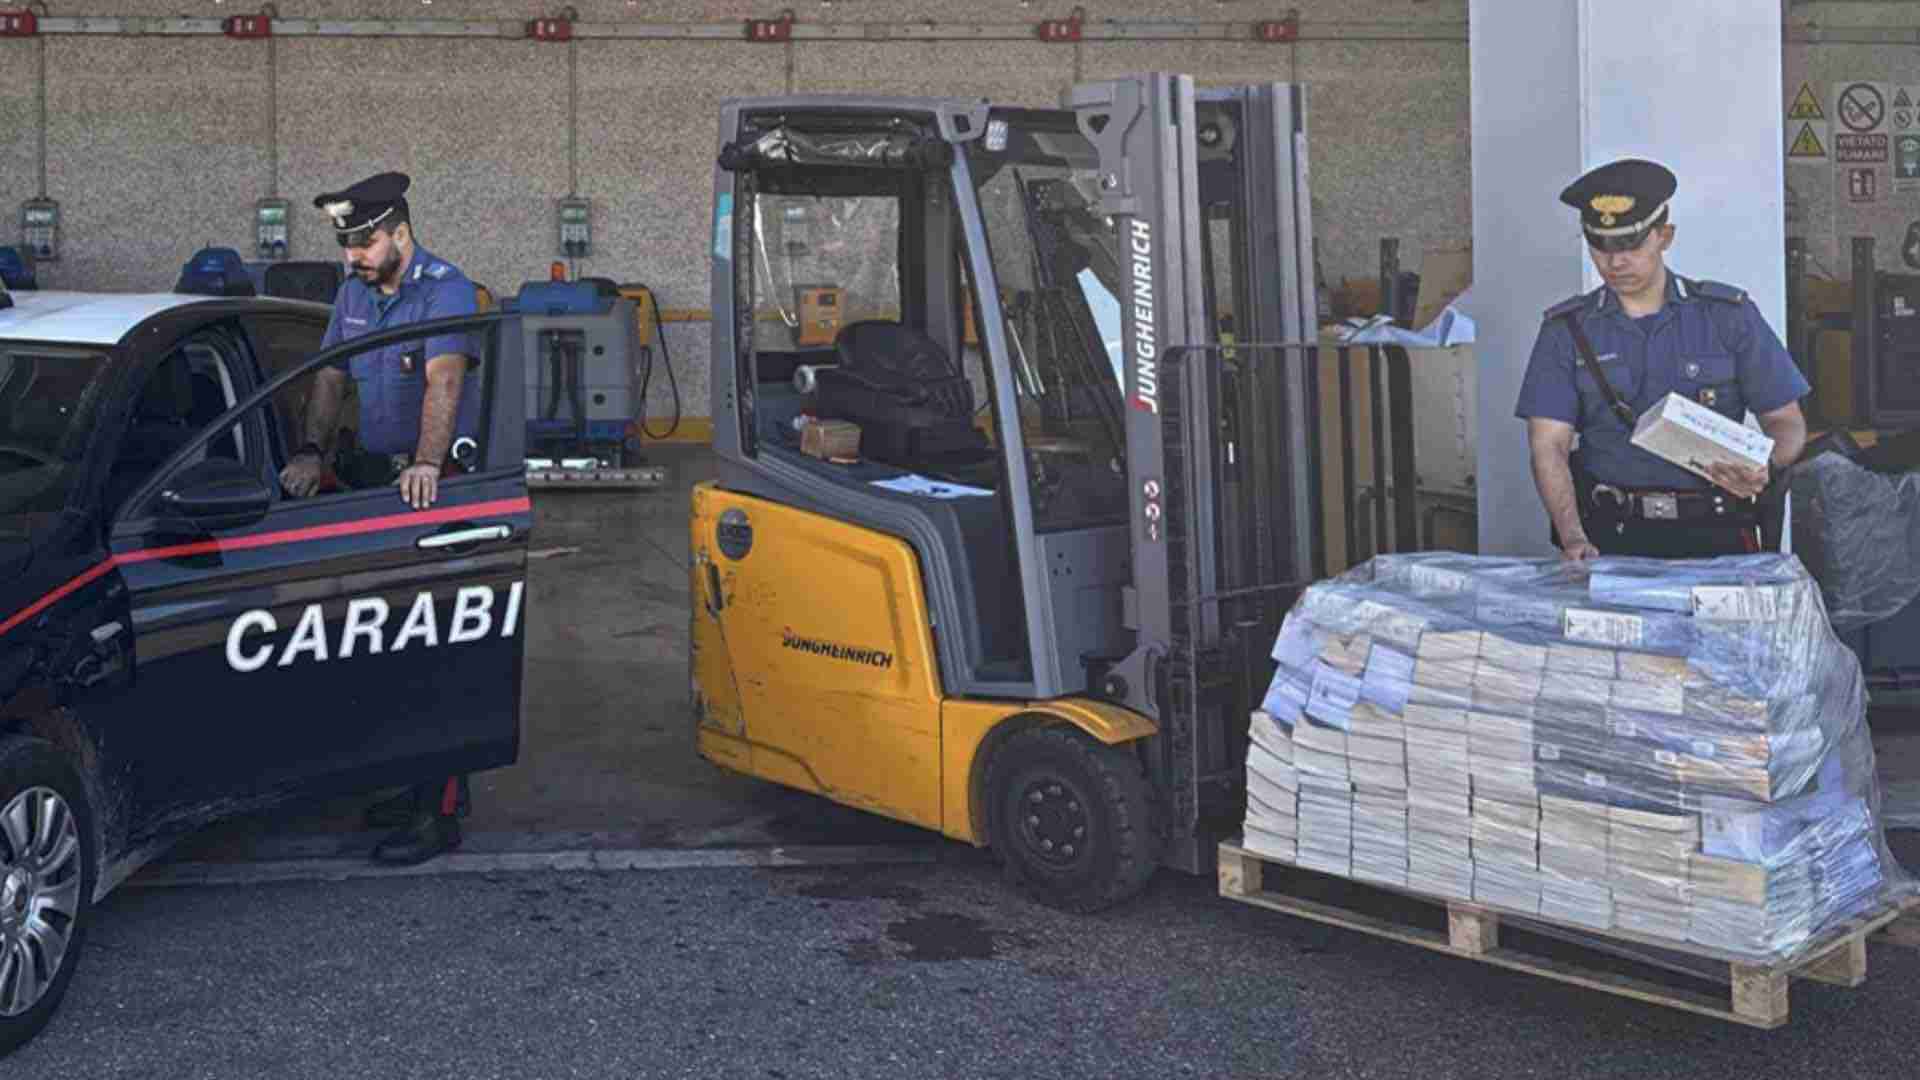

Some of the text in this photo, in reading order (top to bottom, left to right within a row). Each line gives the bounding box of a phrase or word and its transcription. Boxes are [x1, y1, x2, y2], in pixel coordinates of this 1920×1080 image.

[1132, 220, 1157, 414] JUNGHEINRICH
[226, 581, 523, 672] CARABI
[782, 625, 893, 668] JUNGHEINRICH
